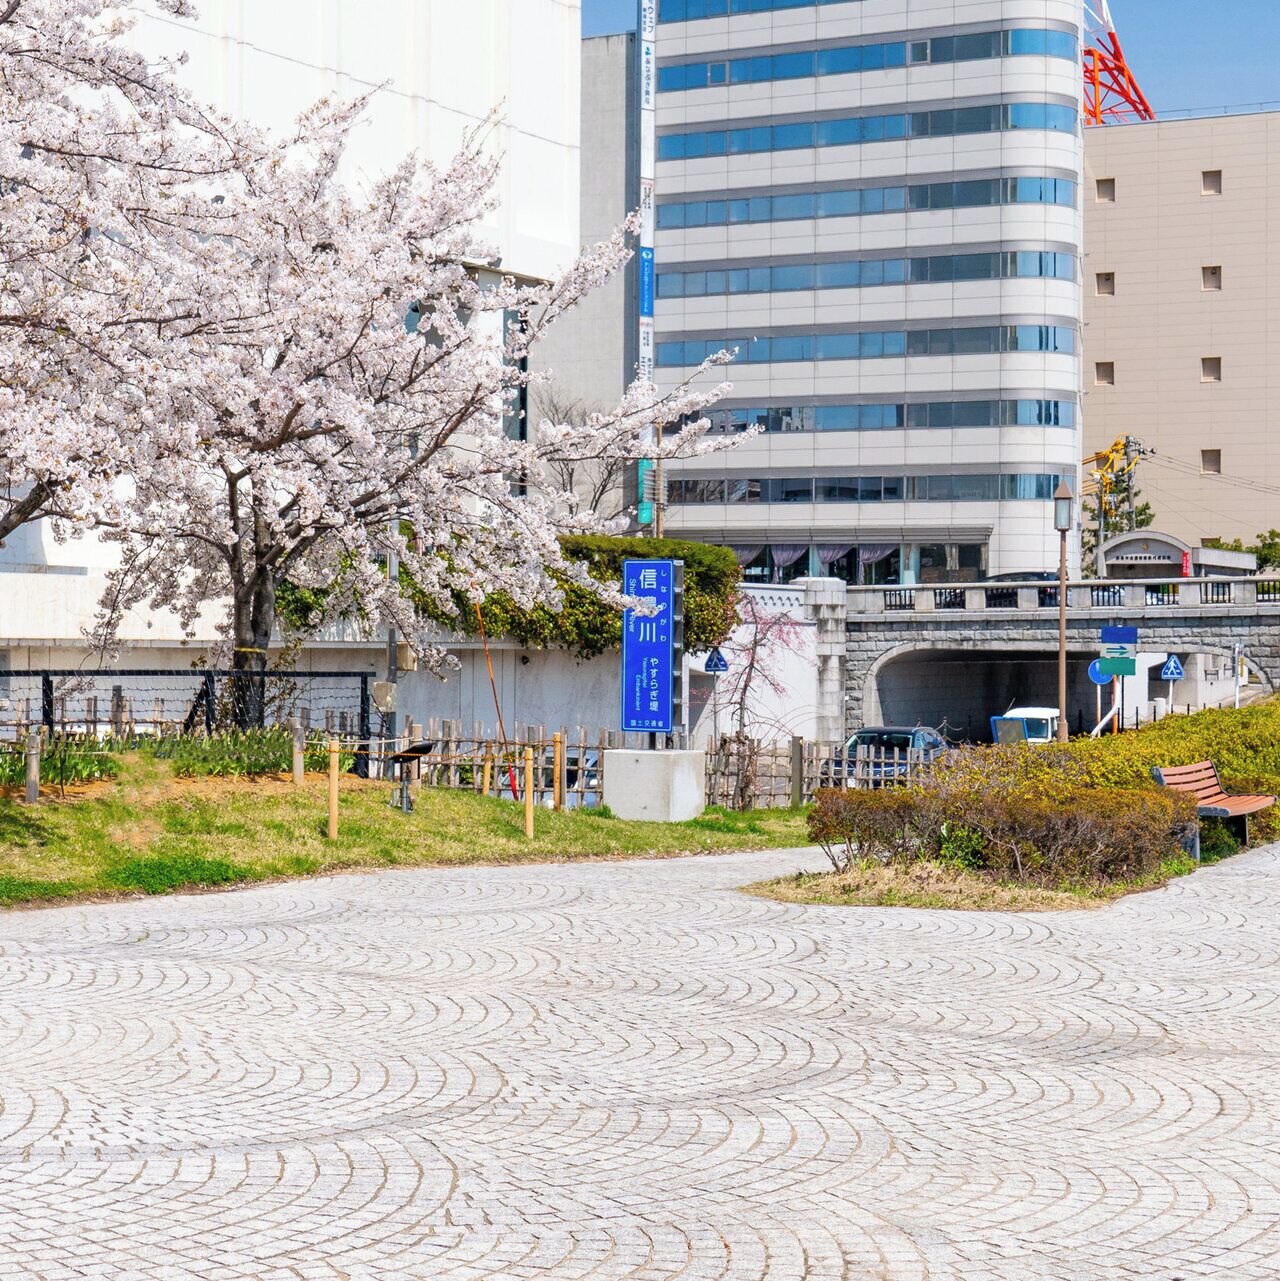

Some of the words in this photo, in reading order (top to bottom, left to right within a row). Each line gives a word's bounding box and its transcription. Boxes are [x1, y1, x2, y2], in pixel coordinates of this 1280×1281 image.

[660, 569, 668, 642] しなのがわ
[649, 657, 659, 712] やすらぎ堤
[630, 719, 664, 728] 国土交通省
